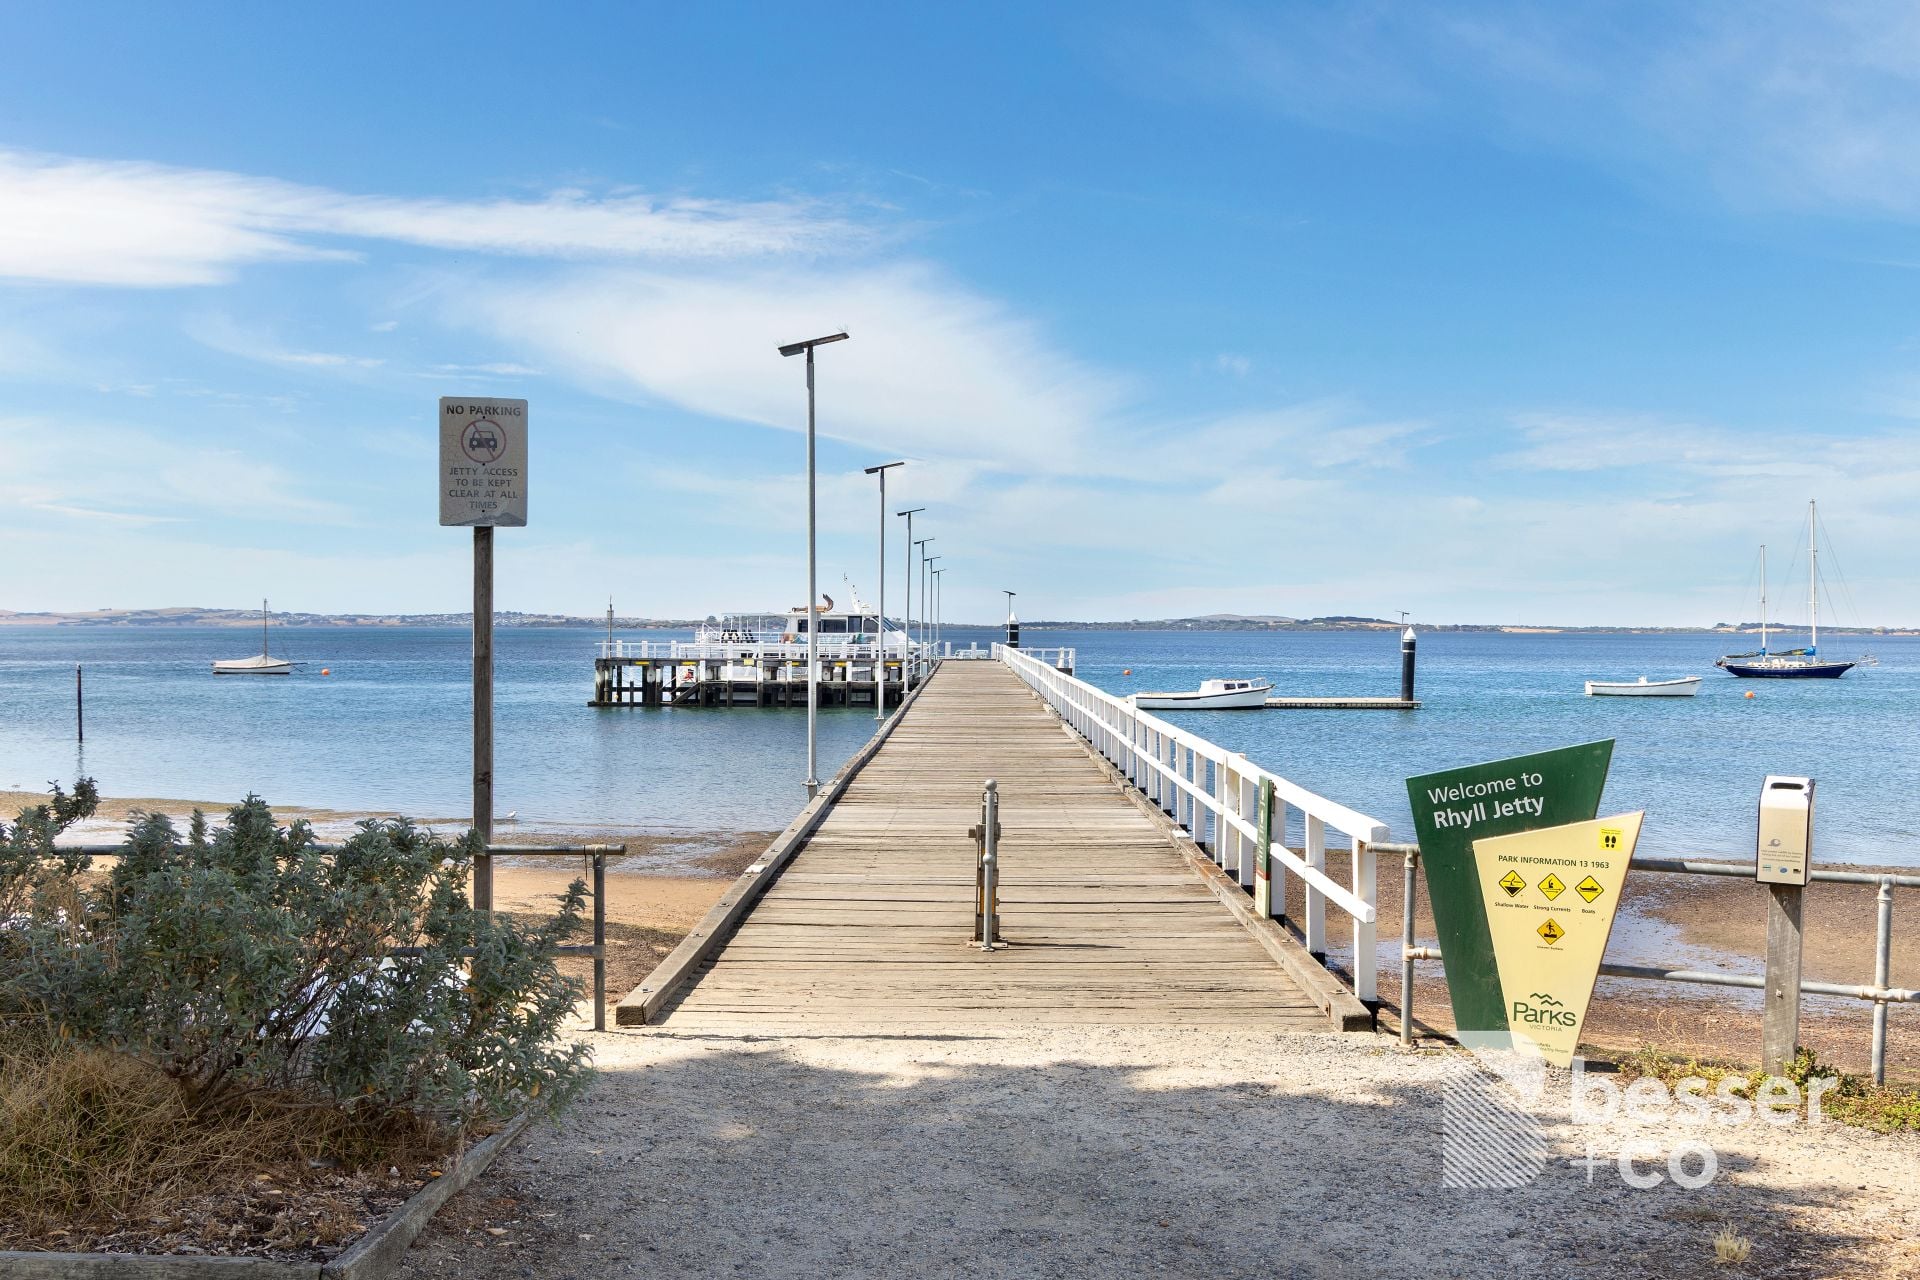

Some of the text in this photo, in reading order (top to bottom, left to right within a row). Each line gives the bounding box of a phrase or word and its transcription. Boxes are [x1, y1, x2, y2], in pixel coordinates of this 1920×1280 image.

[446, 405, 521, 417] NO PARKING
[449, 467, 518, 477] JETTY ACCESS
[455, 478, 512, 487] TO BE KEPT
[448, 489, 518, 499] CLEAR AT ALL
[469, 501, 498, 509] TIMES
[1427, 772, 1543, 804] Welcome to
[1433, 796, 1544, 829] Rhyll Jetty
[1498, 855, 1610, 869] PARK INFORMATION 13 1963
[1533, 904, 1550, 912] Strong
[1513, 1002, 1577, 1027] Parks
[1529, 1024, 1563, 1032] VICTORIA
